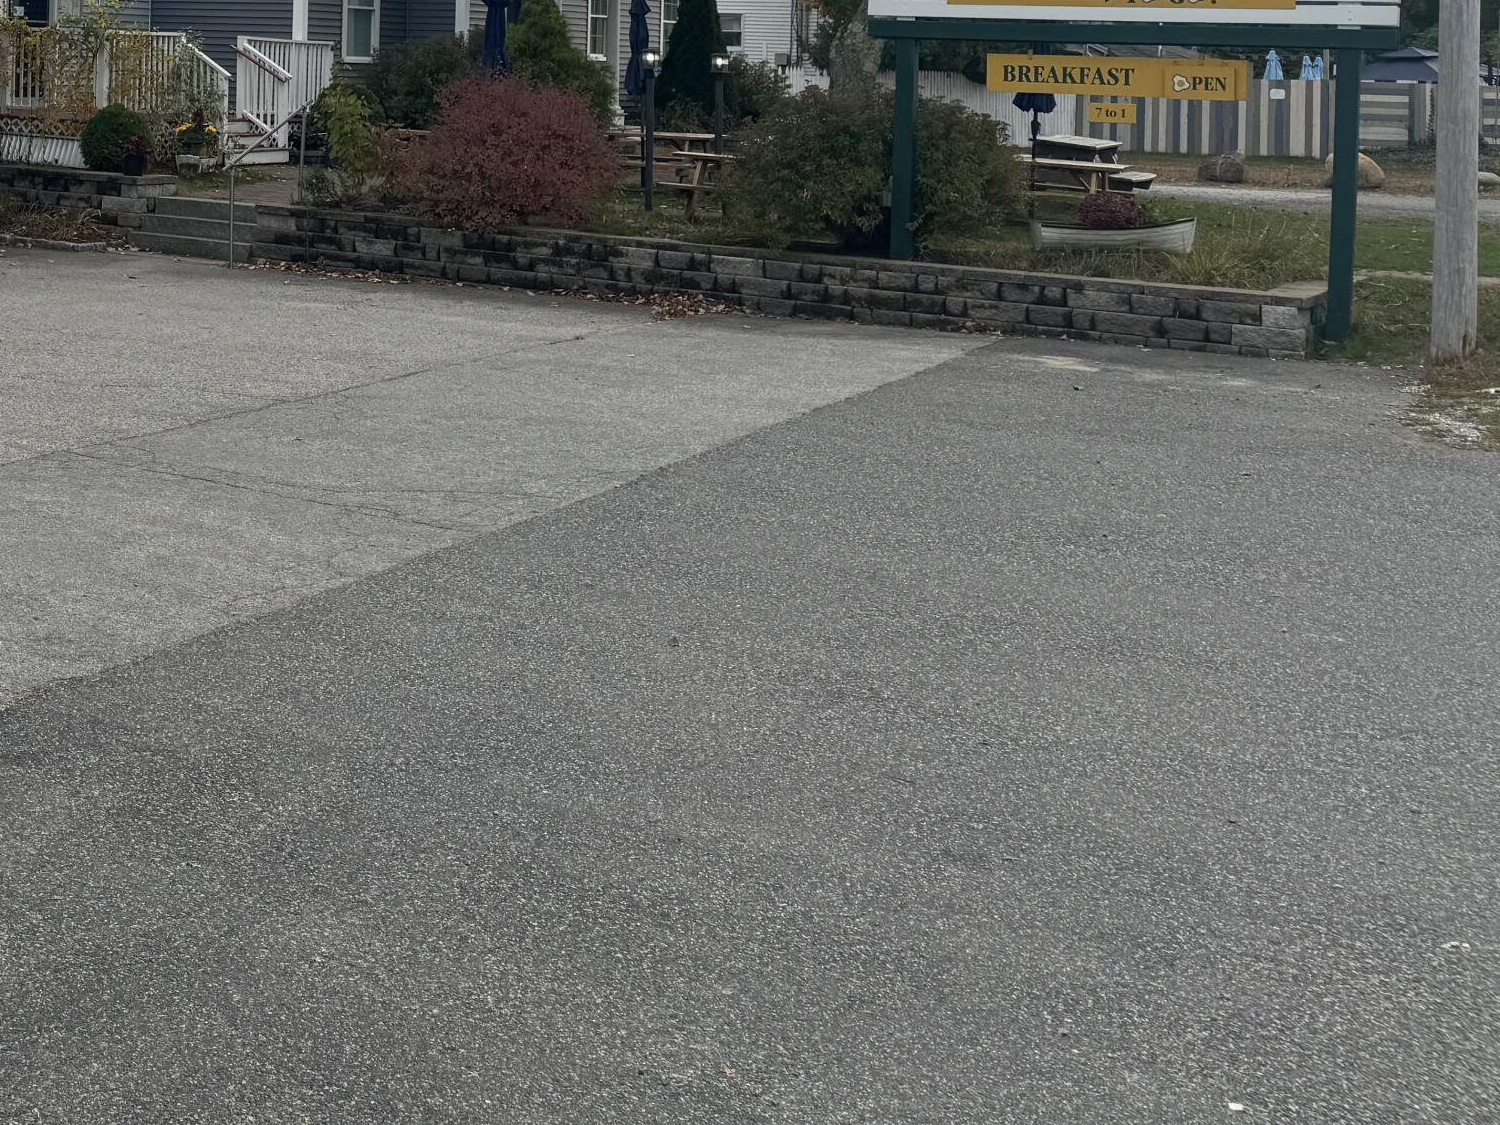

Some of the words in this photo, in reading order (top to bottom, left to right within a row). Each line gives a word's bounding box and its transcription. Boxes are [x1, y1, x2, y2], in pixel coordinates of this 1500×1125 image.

[1002, 64, 1135, 87] BREAKFAST
[1095, 107, 1102, 118] 7
[1105, 107, 1117, 118] to
[1120, 107, 1126, 118] 1
